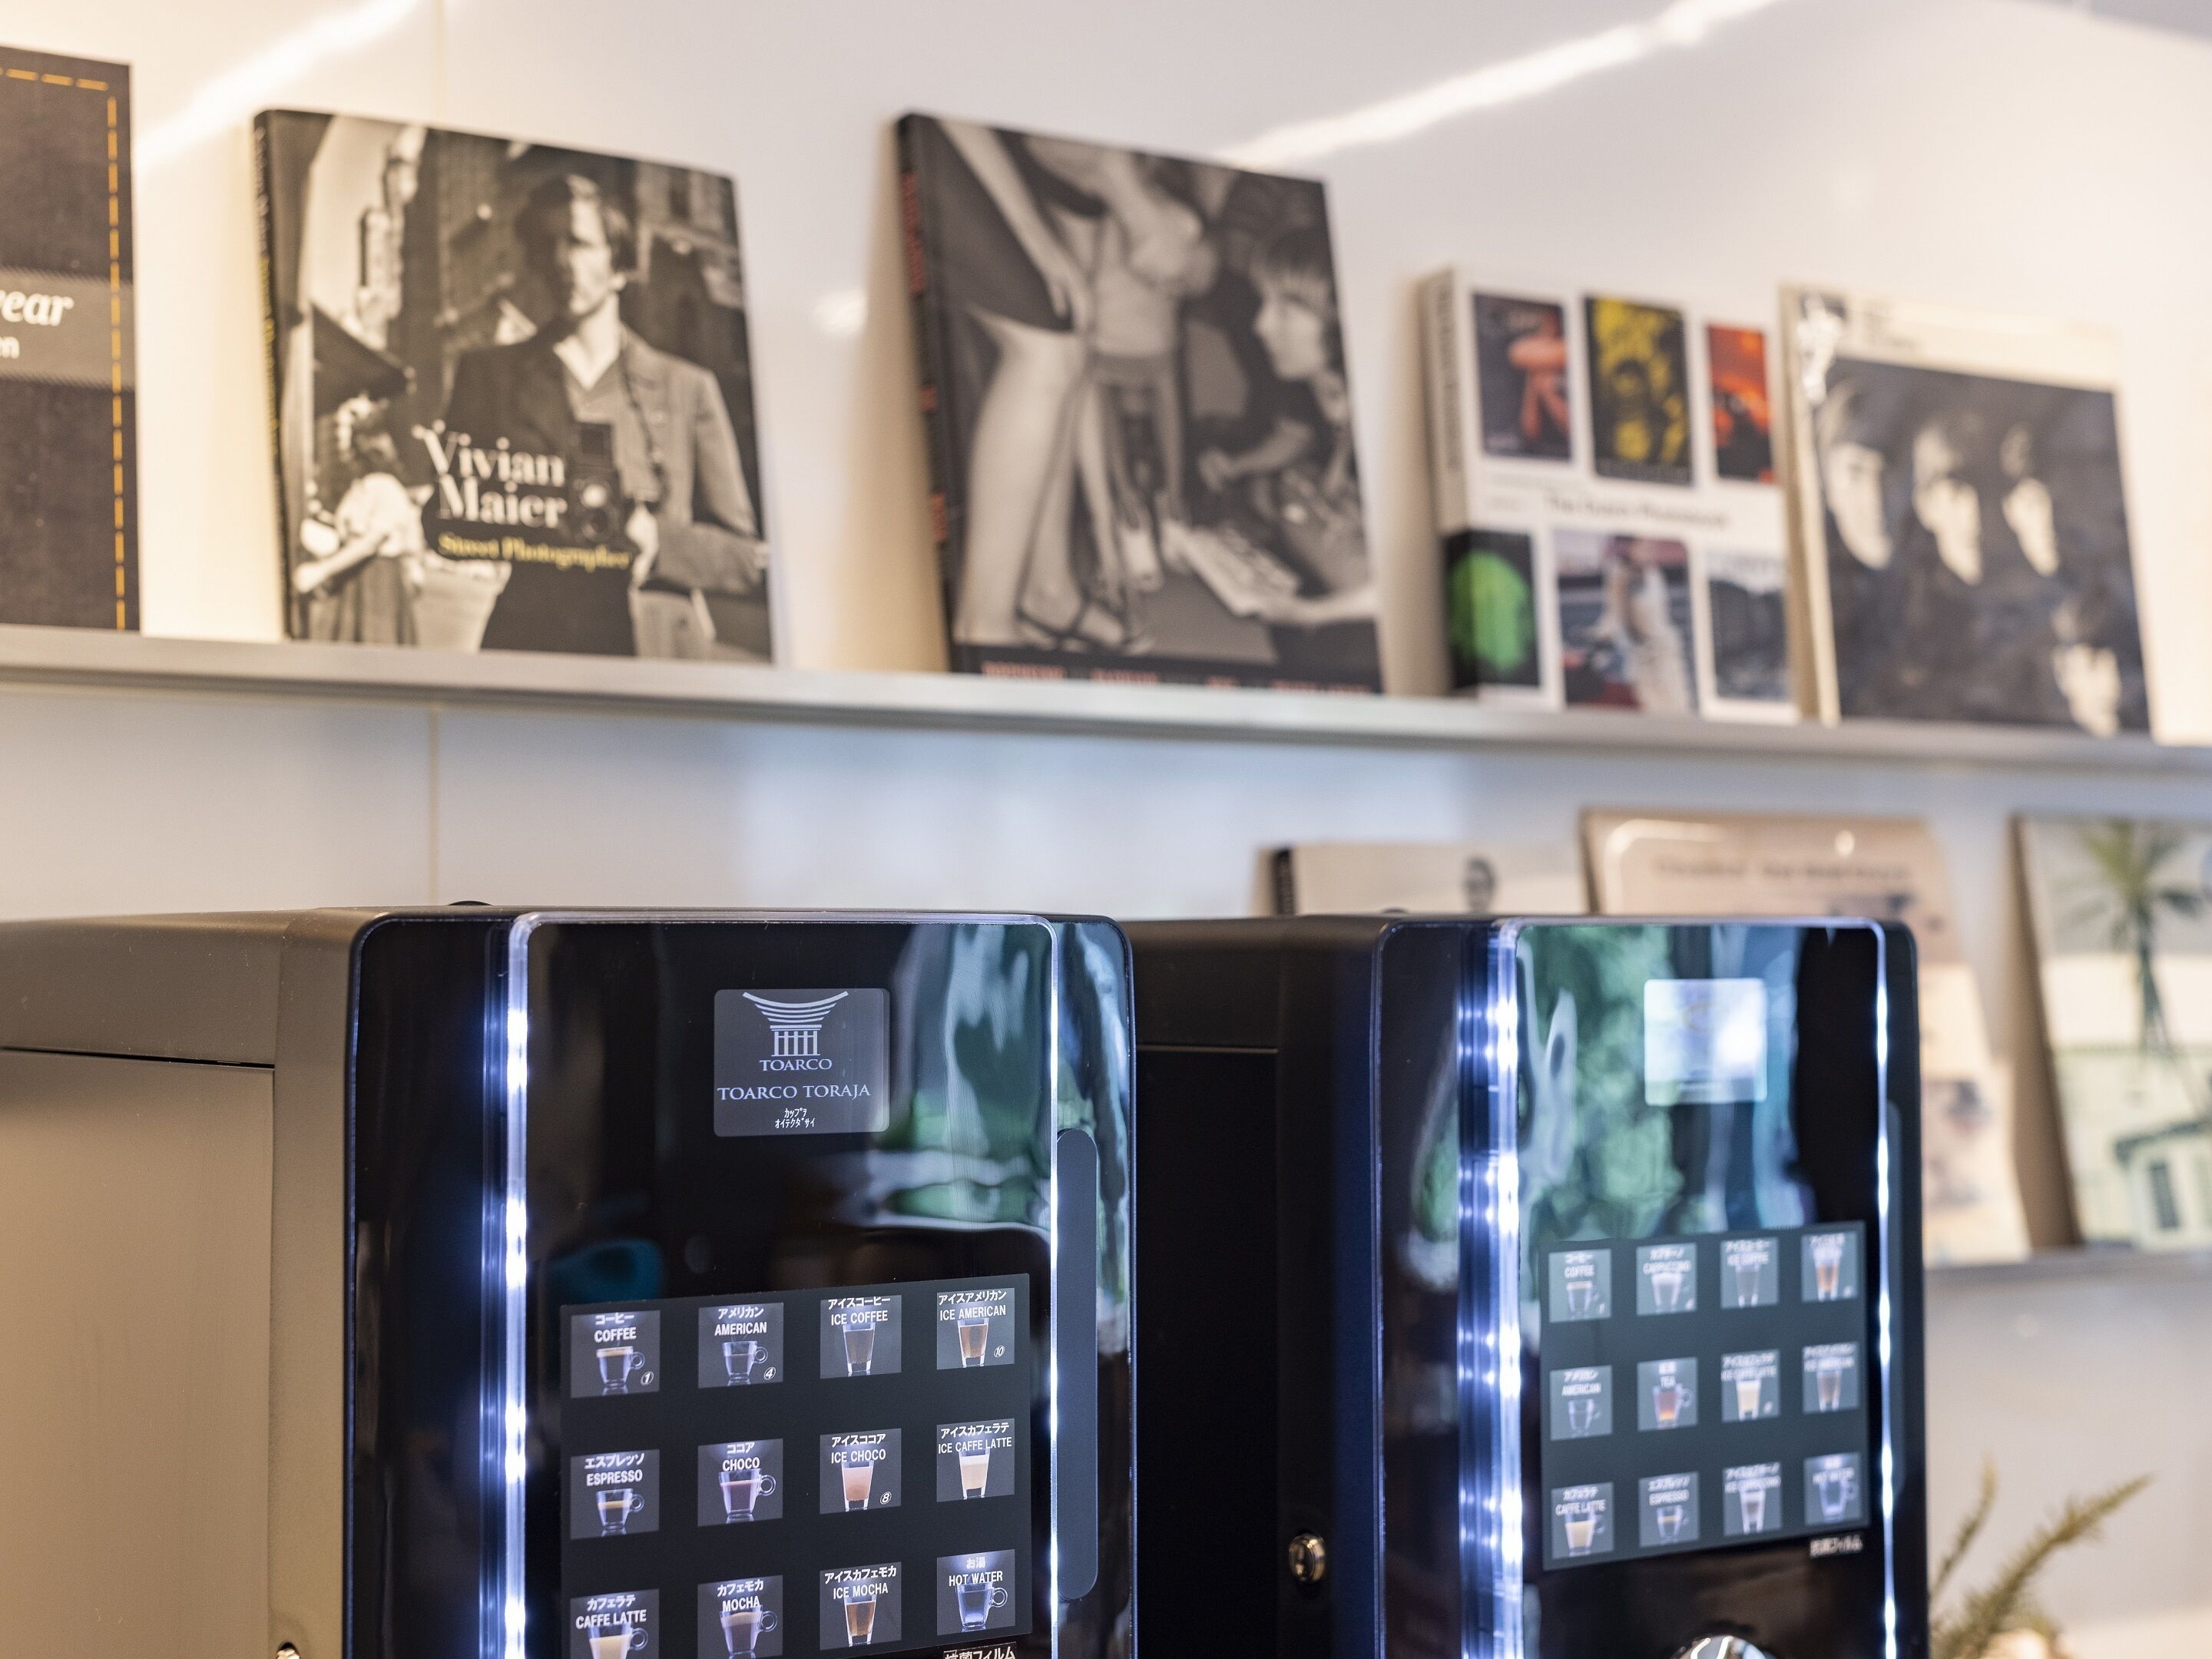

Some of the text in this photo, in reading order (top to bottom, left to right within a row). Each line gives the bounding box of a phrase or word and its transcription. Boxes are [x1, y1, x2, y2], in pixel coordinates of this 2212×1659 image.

[411, 418, 565, 488] Vivian
[438, 472, 568, 528] Maier
[759, 1058, 833, 1072] TOARCO
[717, 1084, 871, 1101] TOARCO TORAJA
[828, 1296, 891, 1310] アイスコーヒー
[939, 1290, 1007, 1306] アイスアメリカン
[594, 1312, 635, 1326] コーヒー
[718, 1306, 764, 1320] アメリカン
[831, 1310, 889, 1326] ICE COFFEE
[940, 1304, 1006, 1321] ICE AMERICAN
[594, 1326, 637, 1343] COFFEE
[714, 1321, 767, 1336] AMERICAN
[940, 1422, 1010, 1439] アイスカフェラテ
[727, 1442, 755, 1455] ココア
[831, 1433, 886, 1448] アイスココア
[938, 1436, 1012, 1454] ICE CAFFE LATTE
[722, 1456, 760, 1472] CHOCO
[831, 1449, 886, 1464] ICE CHOCO
[586, 1469, 643, 1487] ESPRESSO
[966, 1556, 985, 1568] お湯
[824, 1565, 897, 1584] アイスカフェモカ
[949, 1571, 1003, 1587] HOT WATER
[717, 1579, 764, 1597] カフェモカ
[833, 1582, 889, 1600] ICE MOCHA
[587, 1594, 635, 1611] カフェラテ
[722, 1595, 760, 1611] MOCHA
[575, 1609, 647, 1629] CAFFE LATTE
